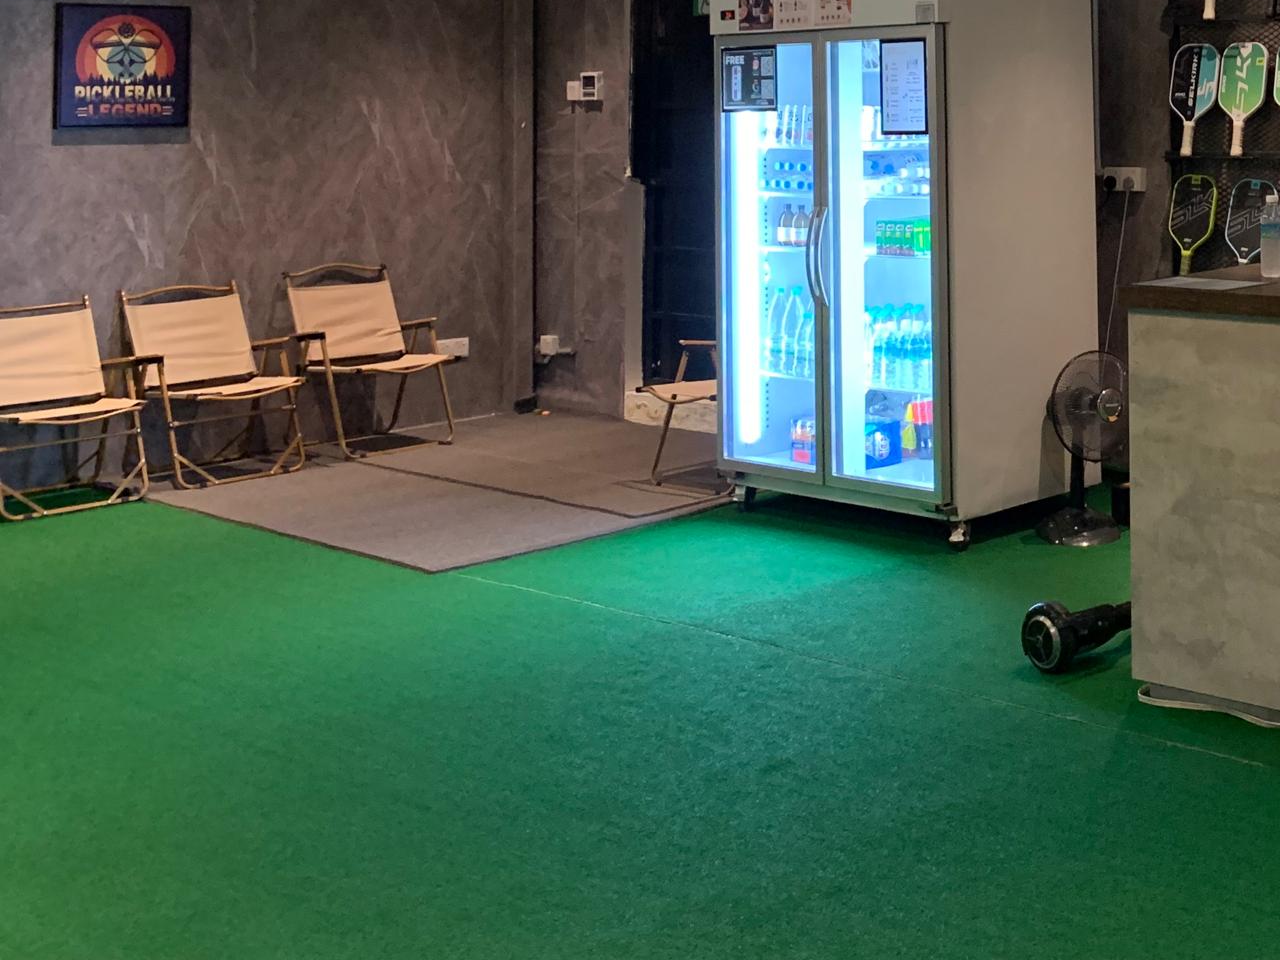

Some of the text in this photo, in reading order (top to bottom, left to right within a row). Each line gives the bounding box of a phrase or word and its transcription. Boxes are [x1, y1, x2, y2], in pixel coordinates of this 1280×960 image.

[725, 55, 745, 65] FREE
[1187, 53, 1200, 108] SELKIRK
[74, 84, 175, 102] PICKLEBALL
[87, 103, 162, 117] LEGEND
